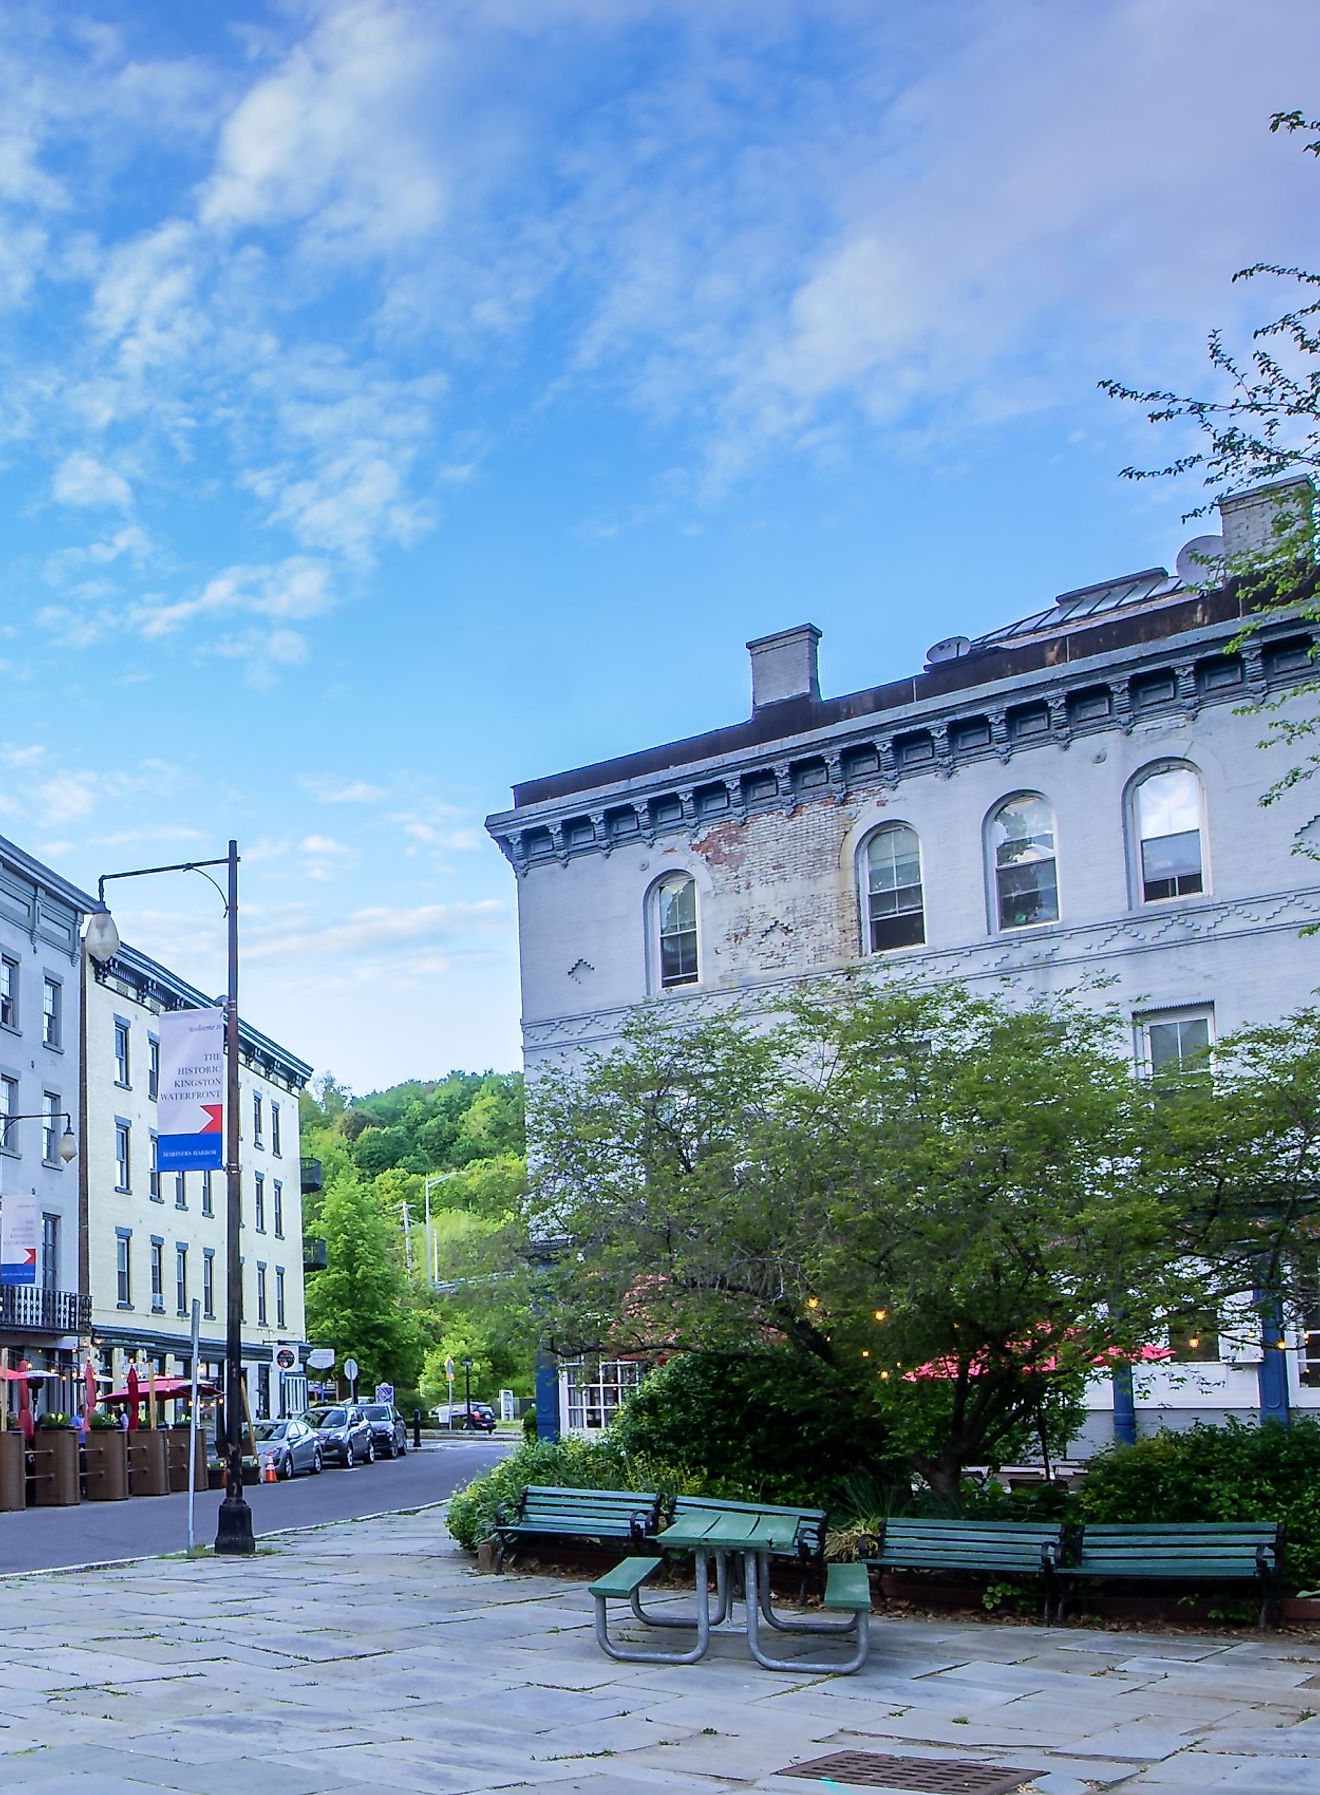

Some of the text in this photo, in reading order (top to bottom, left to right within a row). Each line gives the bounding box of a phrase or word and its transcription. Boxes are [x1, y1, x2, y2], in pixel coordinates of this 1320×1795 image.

[178, 1066, 221, 1075] HISTORIC
[174, 1079, 221, 1088] KINGSTON
[160, 1091, 221, 1101] WATERFRONT
